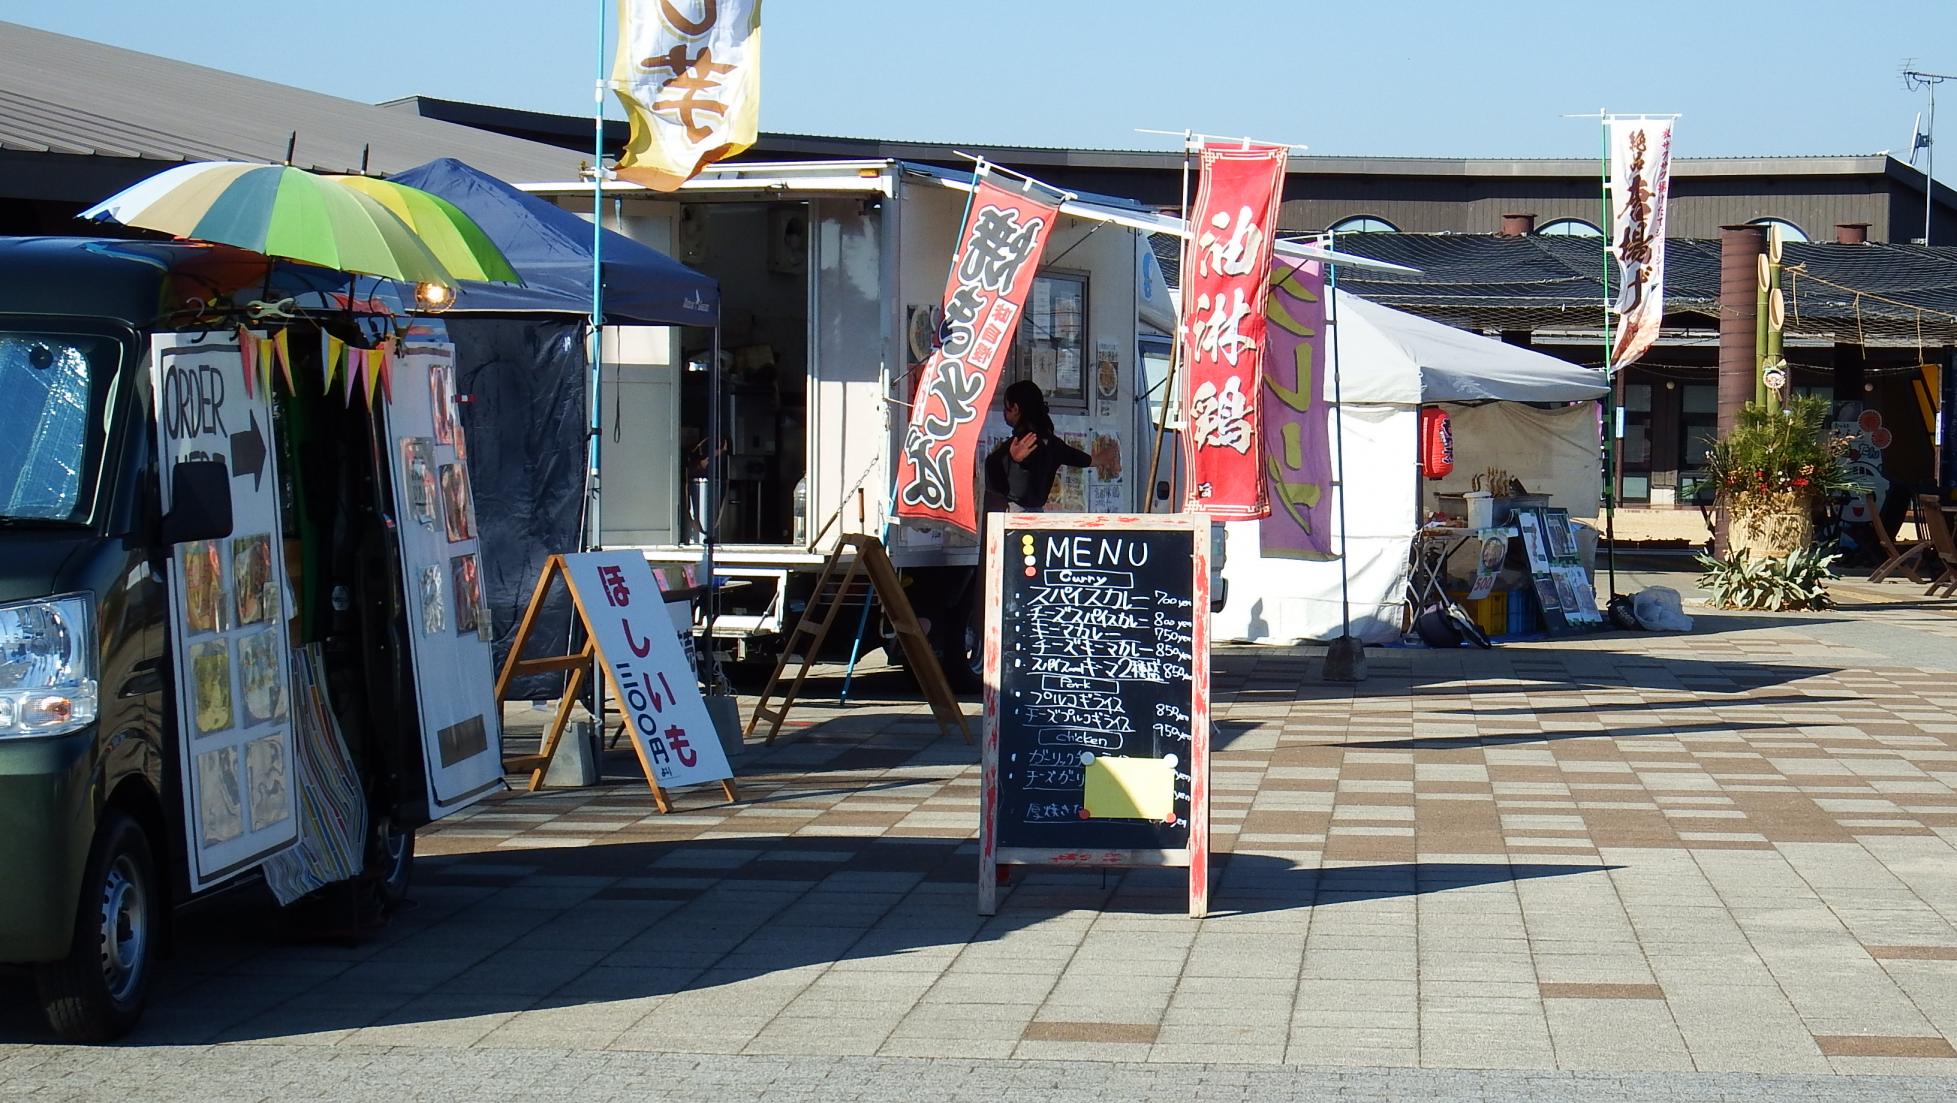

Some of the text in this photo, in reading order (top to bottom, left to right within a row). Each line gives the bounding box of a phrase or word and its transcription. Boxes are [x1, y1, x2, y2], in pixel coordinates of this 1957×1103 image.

[971, 303, 1010, 363] 味自慢
[1190, 205, 1263, 455] 油淋鶏
[903, 205, 1044, 512] 焼きそば
[165, 364, 228, 440] ORDER
[1046, 537, 1148, 567] MENU
[1059, 572, 1107, 585] Curry
[1027, 586, 1150, 609] スパイスカレー
[1027, 607, 1148, 628] チーズスパイスカレー
[1030, 620, 1121, 640] キーマカレー
[1031, 639, 1153, 657] チーズキーマカレー
[597, 565, 697, 767] ほしいも
[1060, 676, 1091, 689] Pork
[1030, 691, 1126, 713] プルコギライス
[1025, 708, 1132, 732] チーズプルコギライス
